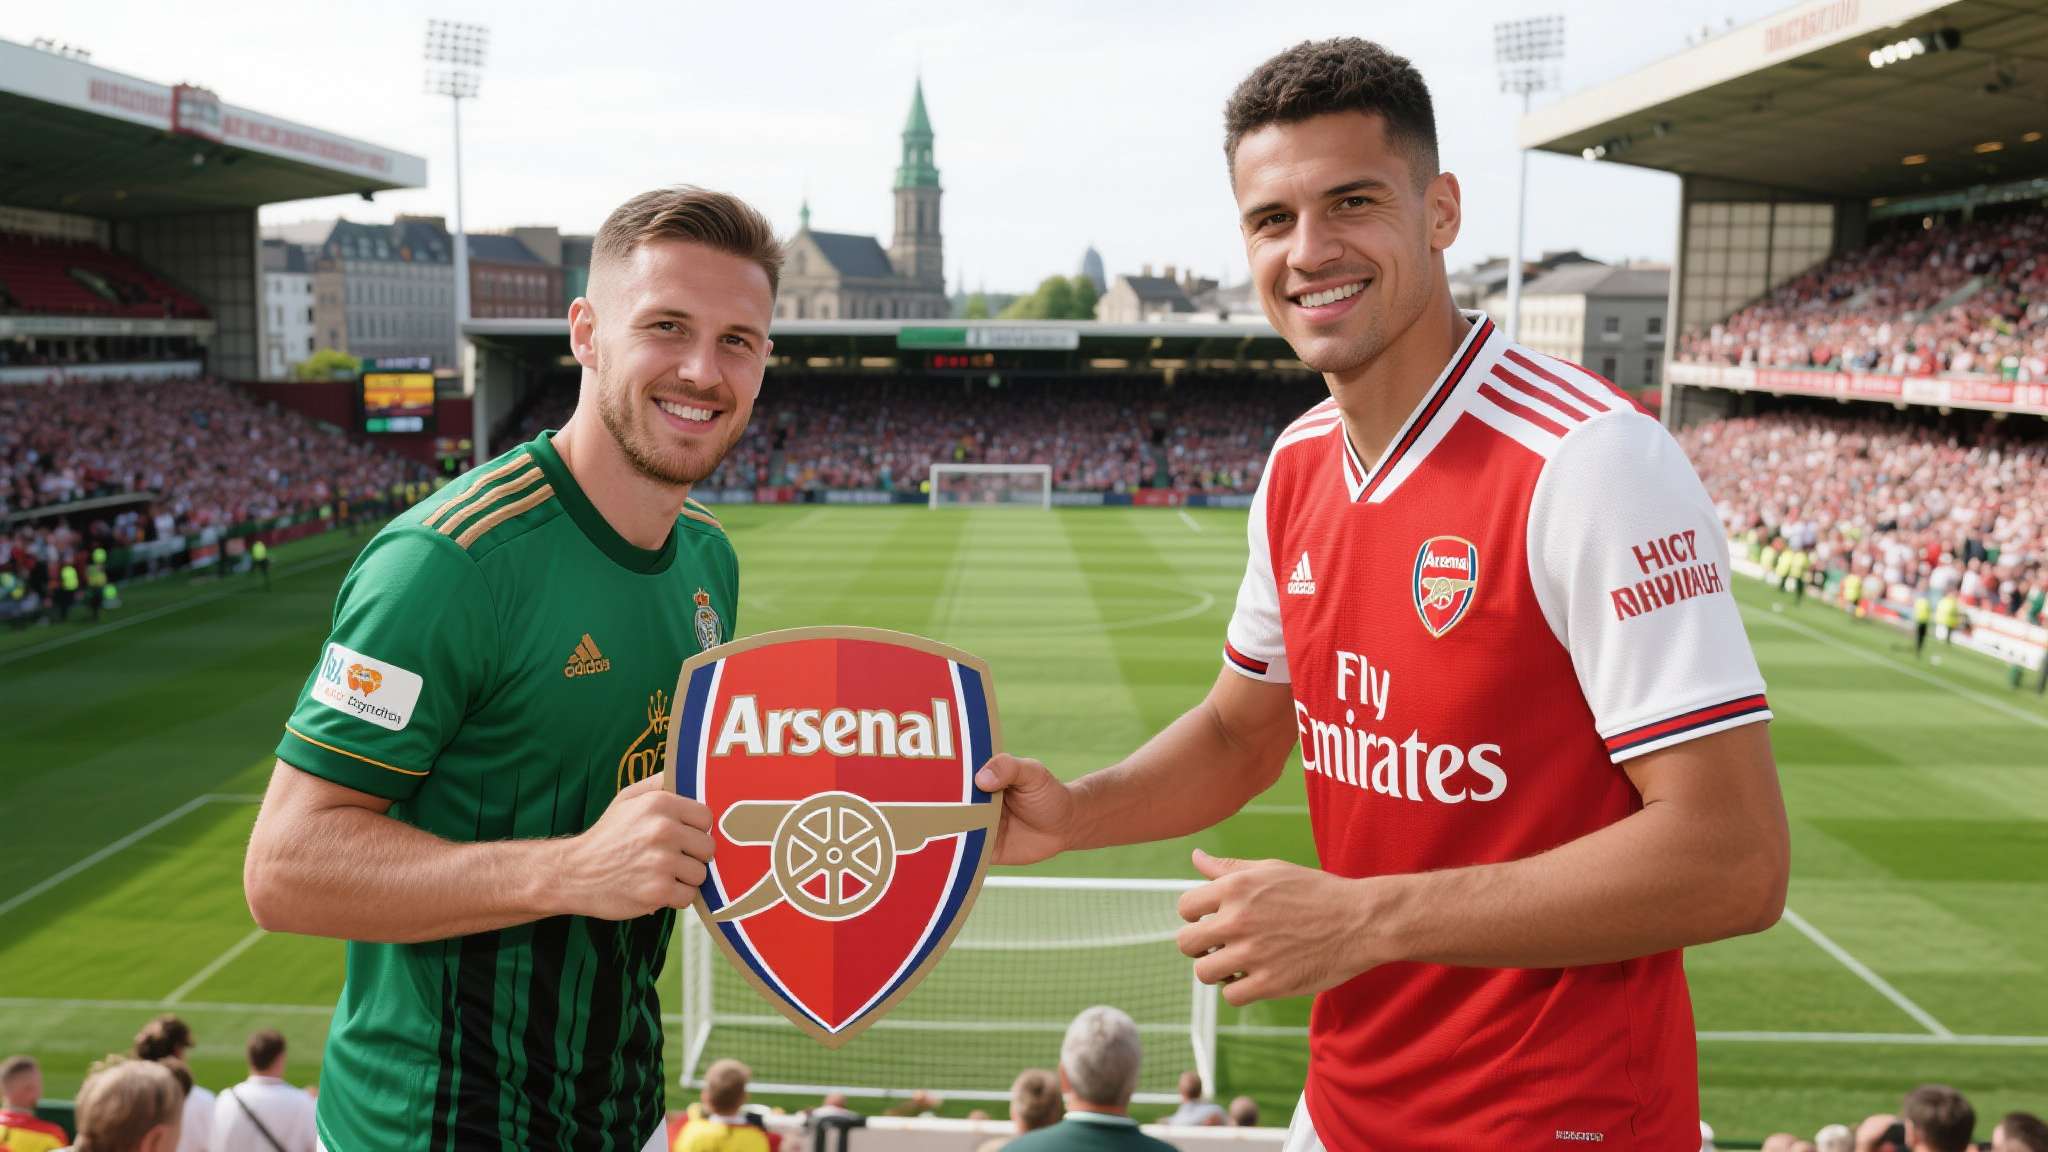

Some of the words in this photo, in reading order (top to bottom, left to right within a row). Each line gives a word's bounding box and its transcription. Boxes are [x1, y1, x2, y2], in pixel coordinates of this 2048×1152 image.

[1336, 651, 1390, 720] Fly
[712, 695, 956, 760] Arsenal
[1294, 698, 1508, 804] Emirates
